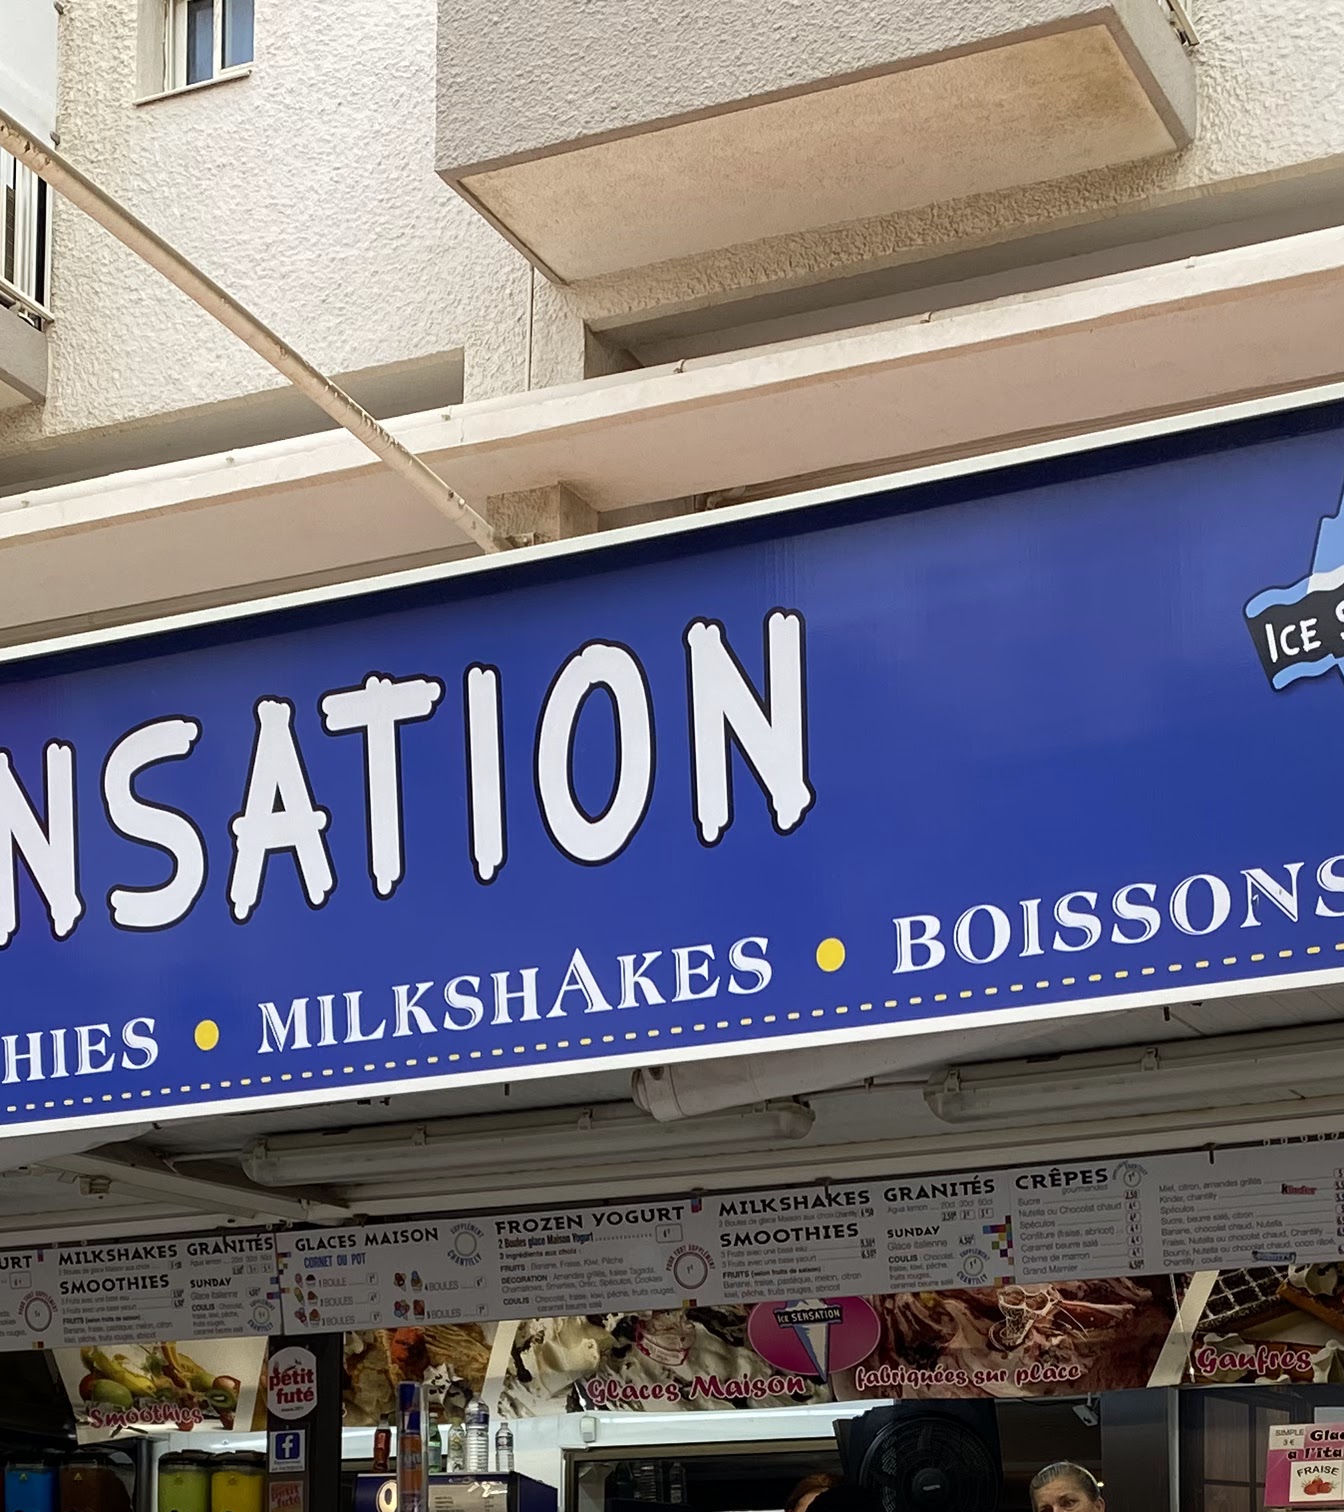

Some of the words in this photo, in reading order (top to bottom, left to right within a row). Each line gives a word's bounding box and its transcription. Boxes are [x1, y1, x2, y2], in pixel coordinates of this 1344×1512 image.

[1266, 615, 1321, 663] ICE
[257, 937, 774, 1054] MILKSHAKES
[1015, 1167, 1108, 1190] CRÊPES
[719, 1190, 870, 1217] MILKSHAKES
[883, 1176, 995, 1203] GRANITÉS
[495, 1214, 583, 1235] FROZEN
[592, 1206, 684, 1227] YOGURT
[295, 1234, 356, 1251] GLACES
[365, 1227, 438, 1246] MAISON
[720, 1222, 859, 1248] SMOOTHIES
[887, 1225, 940, 1239] SUNDAY
[59, 1244, 177, 1266] MILKSHAKES
[187, 1234, 273, 1256] GRANITÉS
[60, 1274, 169, 1295] SMOOTHIES
[190, 1277, 231, 1288] SUNDAY
[777, 1314, 790, 1323] ICE
[791, 1309, 840, 1322] SENSATION
[1196, 1347, 1312, 1377] Gaufres
[269, 1368, 314, 1391] petit
[588, 1378, 681, 1404] Glaces
[689, 1373, 804, 1400] Maison
[857, 1365, 967, 1391] fabriquées
[974, 1369, 1006, 1385] sur
[1016, 1364, 1080, 1387] place
[276, 1387, 315, 1405] futé
[89, 1403, 204, 1428] Smoothies
[1275, 1429, 1304, 1437] SIMPLE
[1296, 1465, 1340, 1478] FRAISE
